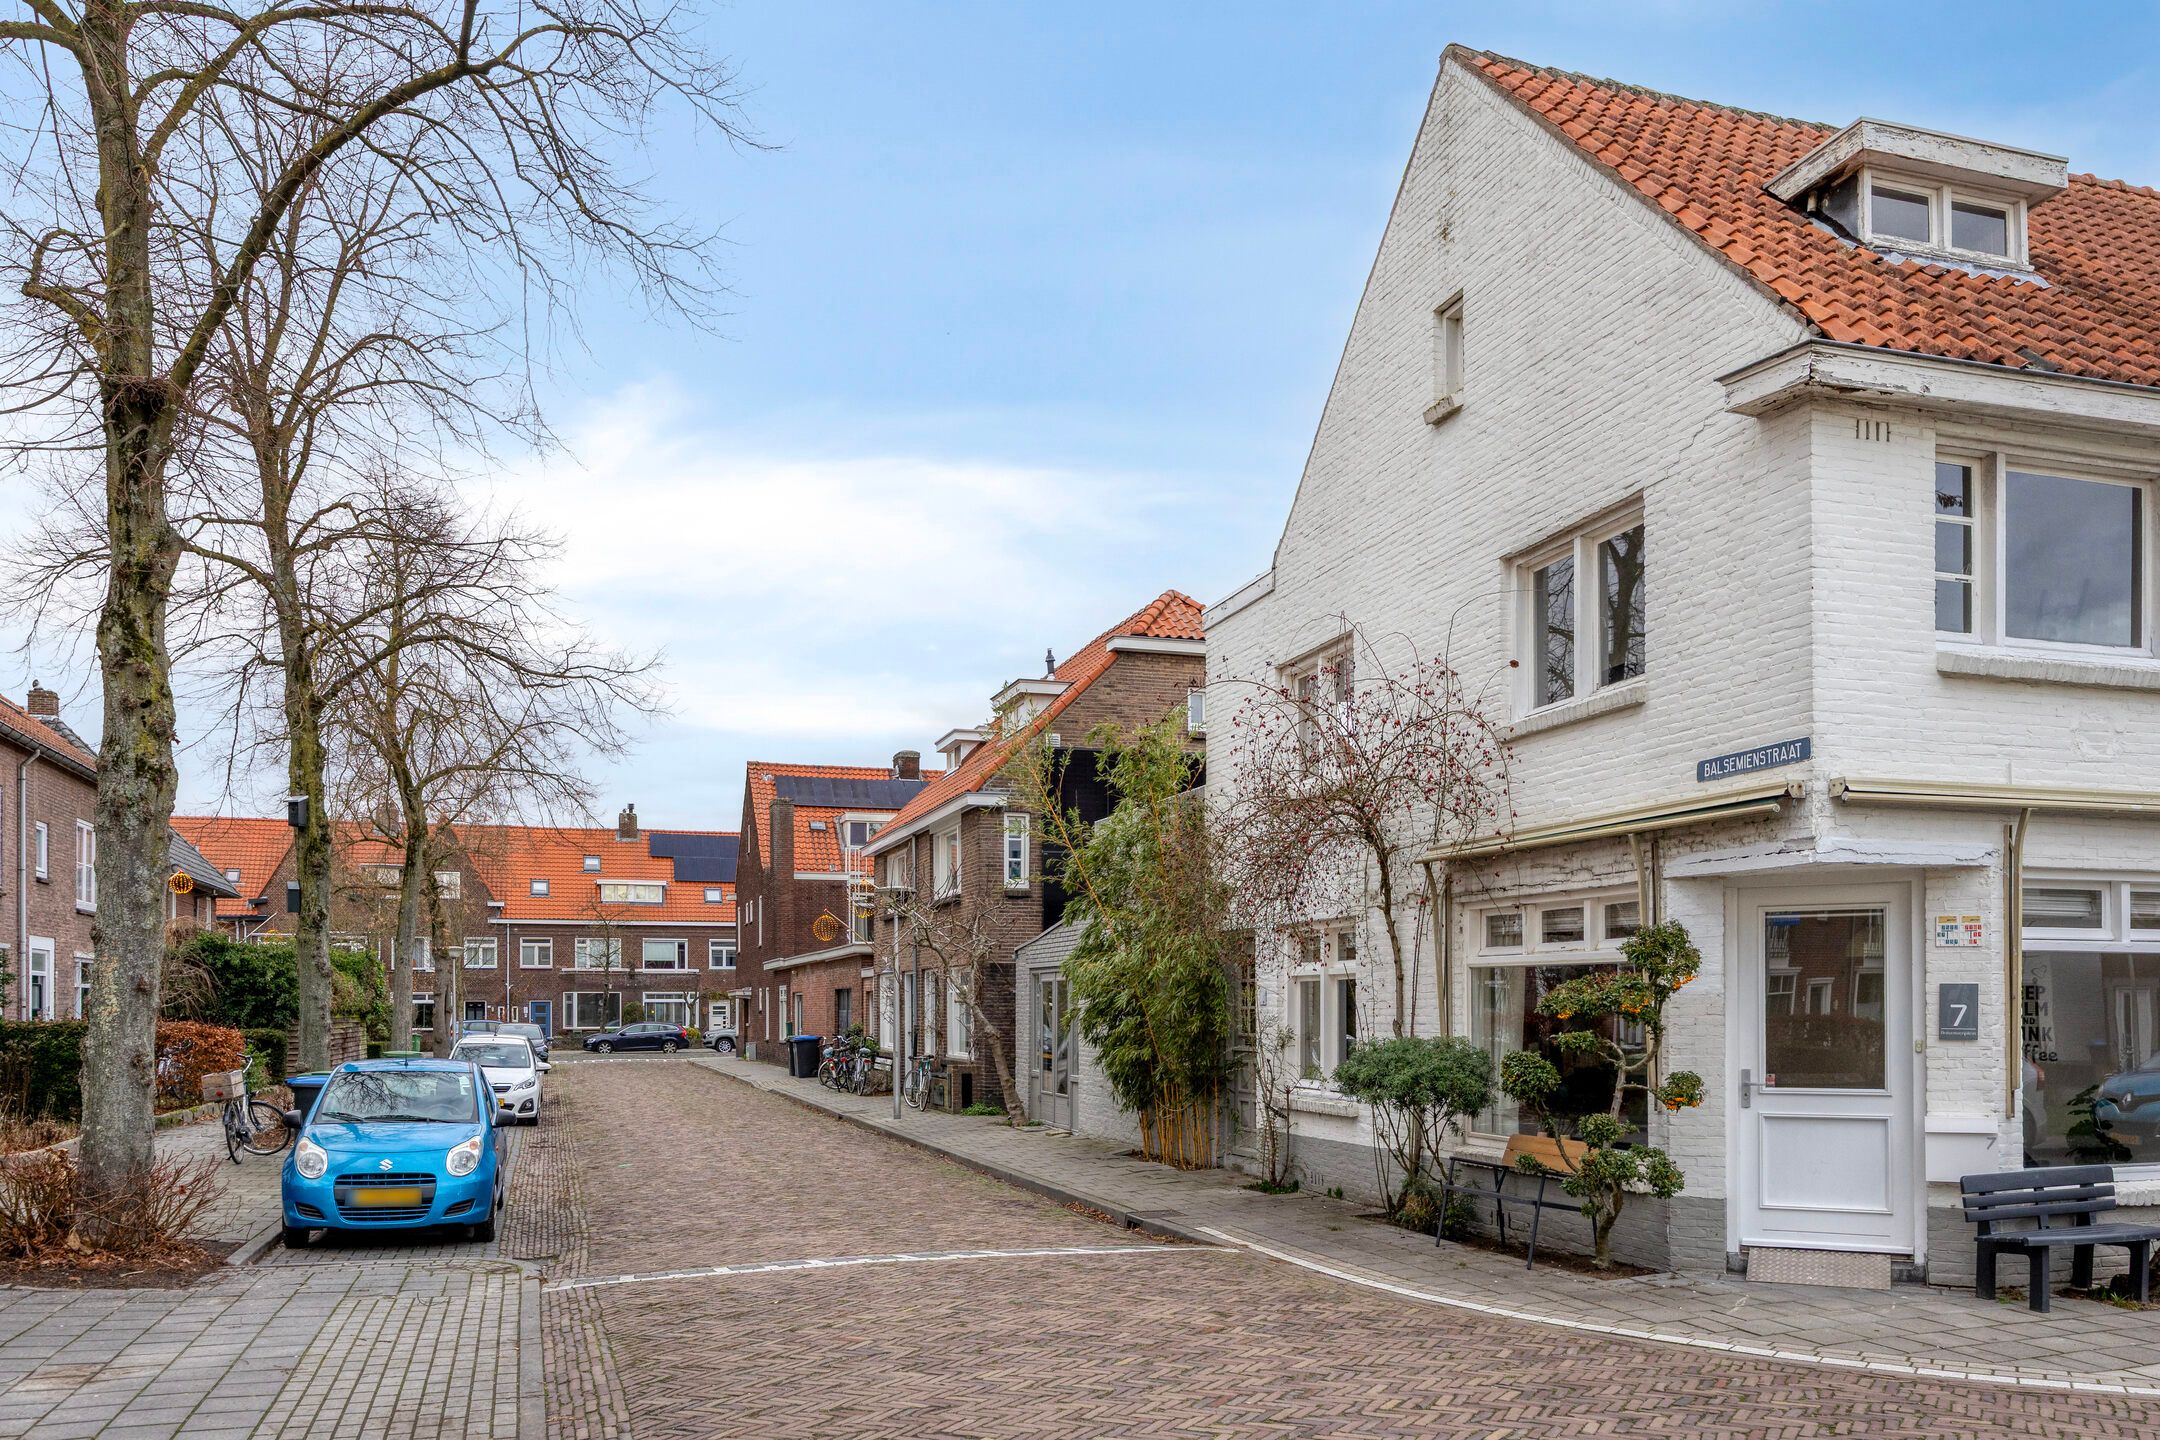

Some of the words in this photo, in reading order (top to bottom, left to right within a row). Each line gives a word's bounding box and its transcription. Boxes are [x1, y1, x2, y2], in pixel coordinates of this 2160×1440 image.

[1704, 742, 1802, 777] BALSEMIENSTRAAT
[2021, 985, 2046, 1000] EP
[1950, 1004, 1967, 1027] 7
[2023, 1001, 2049, 1017] LM
[2022, 1017, 2036, 1025] ND
[2021, 1026, 2053, 1042] INK
[2024, 1043, 2058, 1063] ffee
[1986, 1136, 1997, 1150] 7
